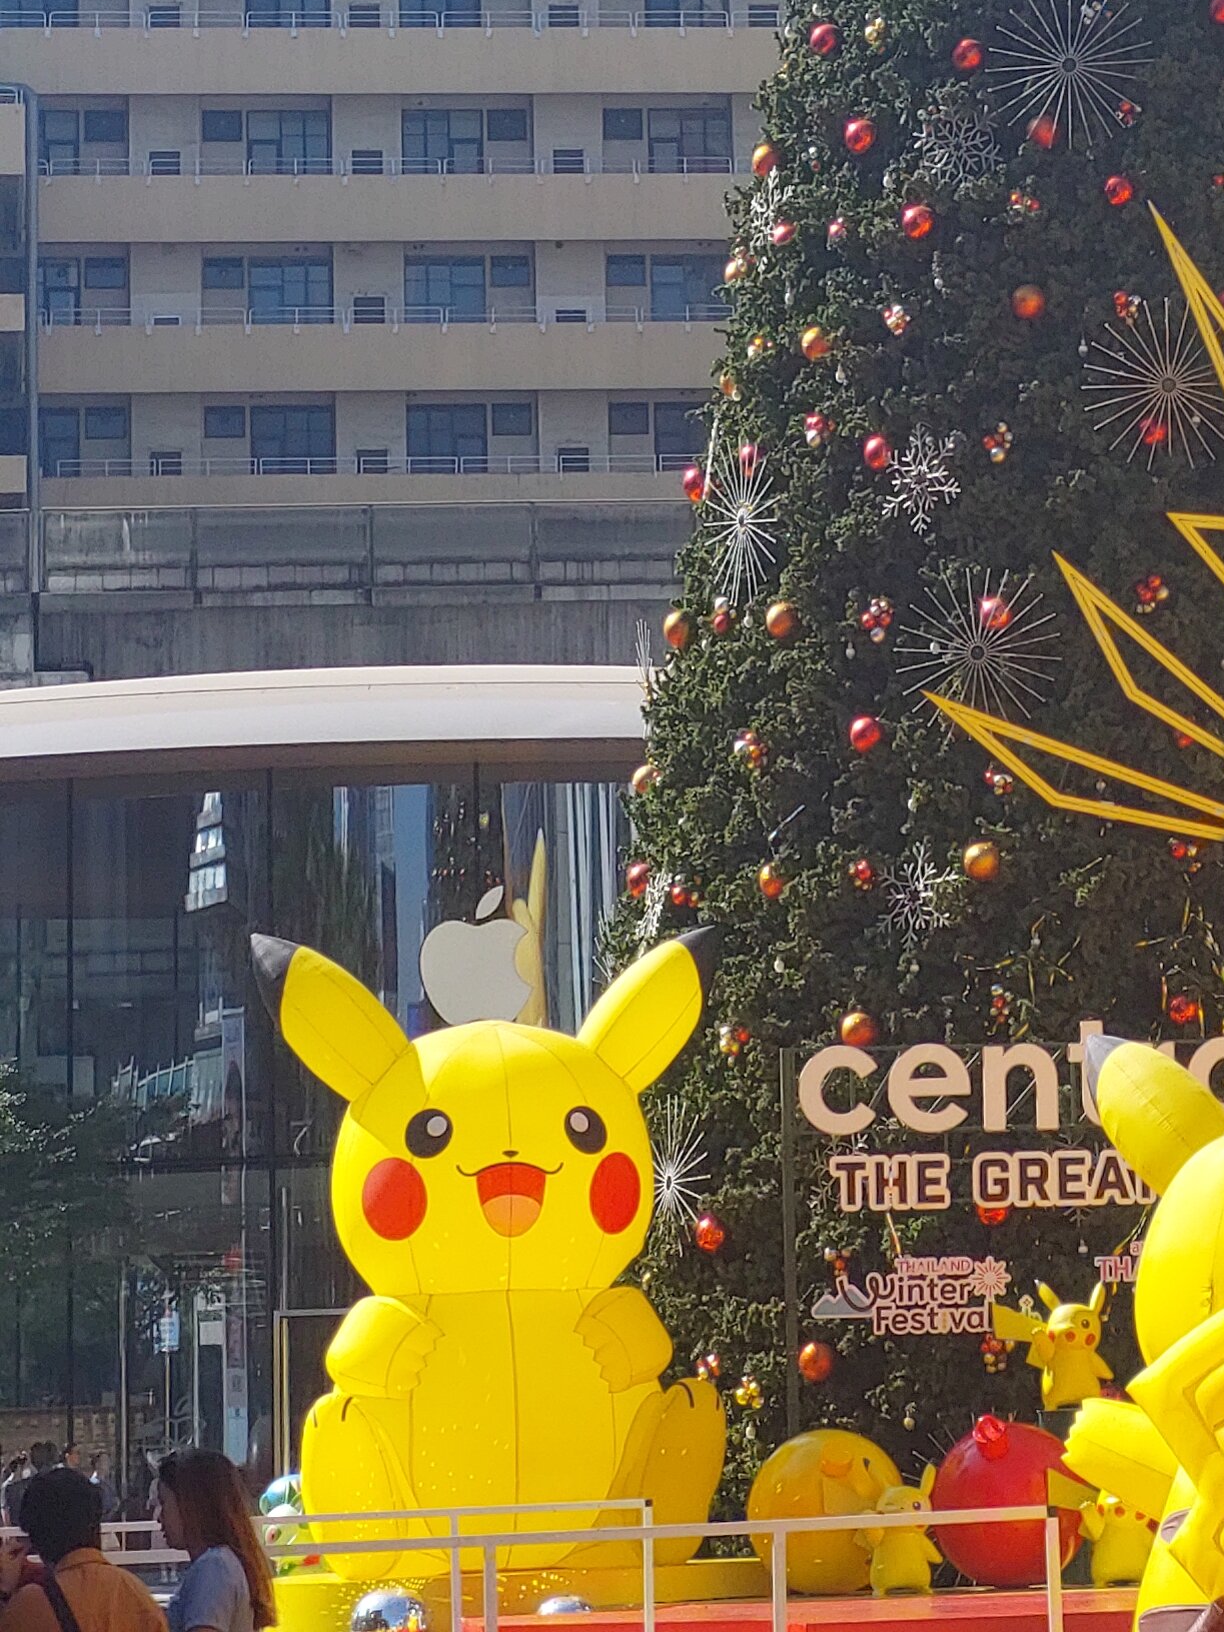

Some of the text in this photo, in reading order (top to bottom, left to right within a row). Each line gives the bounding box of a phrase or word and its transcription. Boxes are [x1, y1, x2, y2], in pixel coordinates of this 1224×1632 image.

[829, 1152, 952, 1212] THE
[895, 1257, 974, 1276] THAILAND
[836, 1272, 973, 1312] Winter
